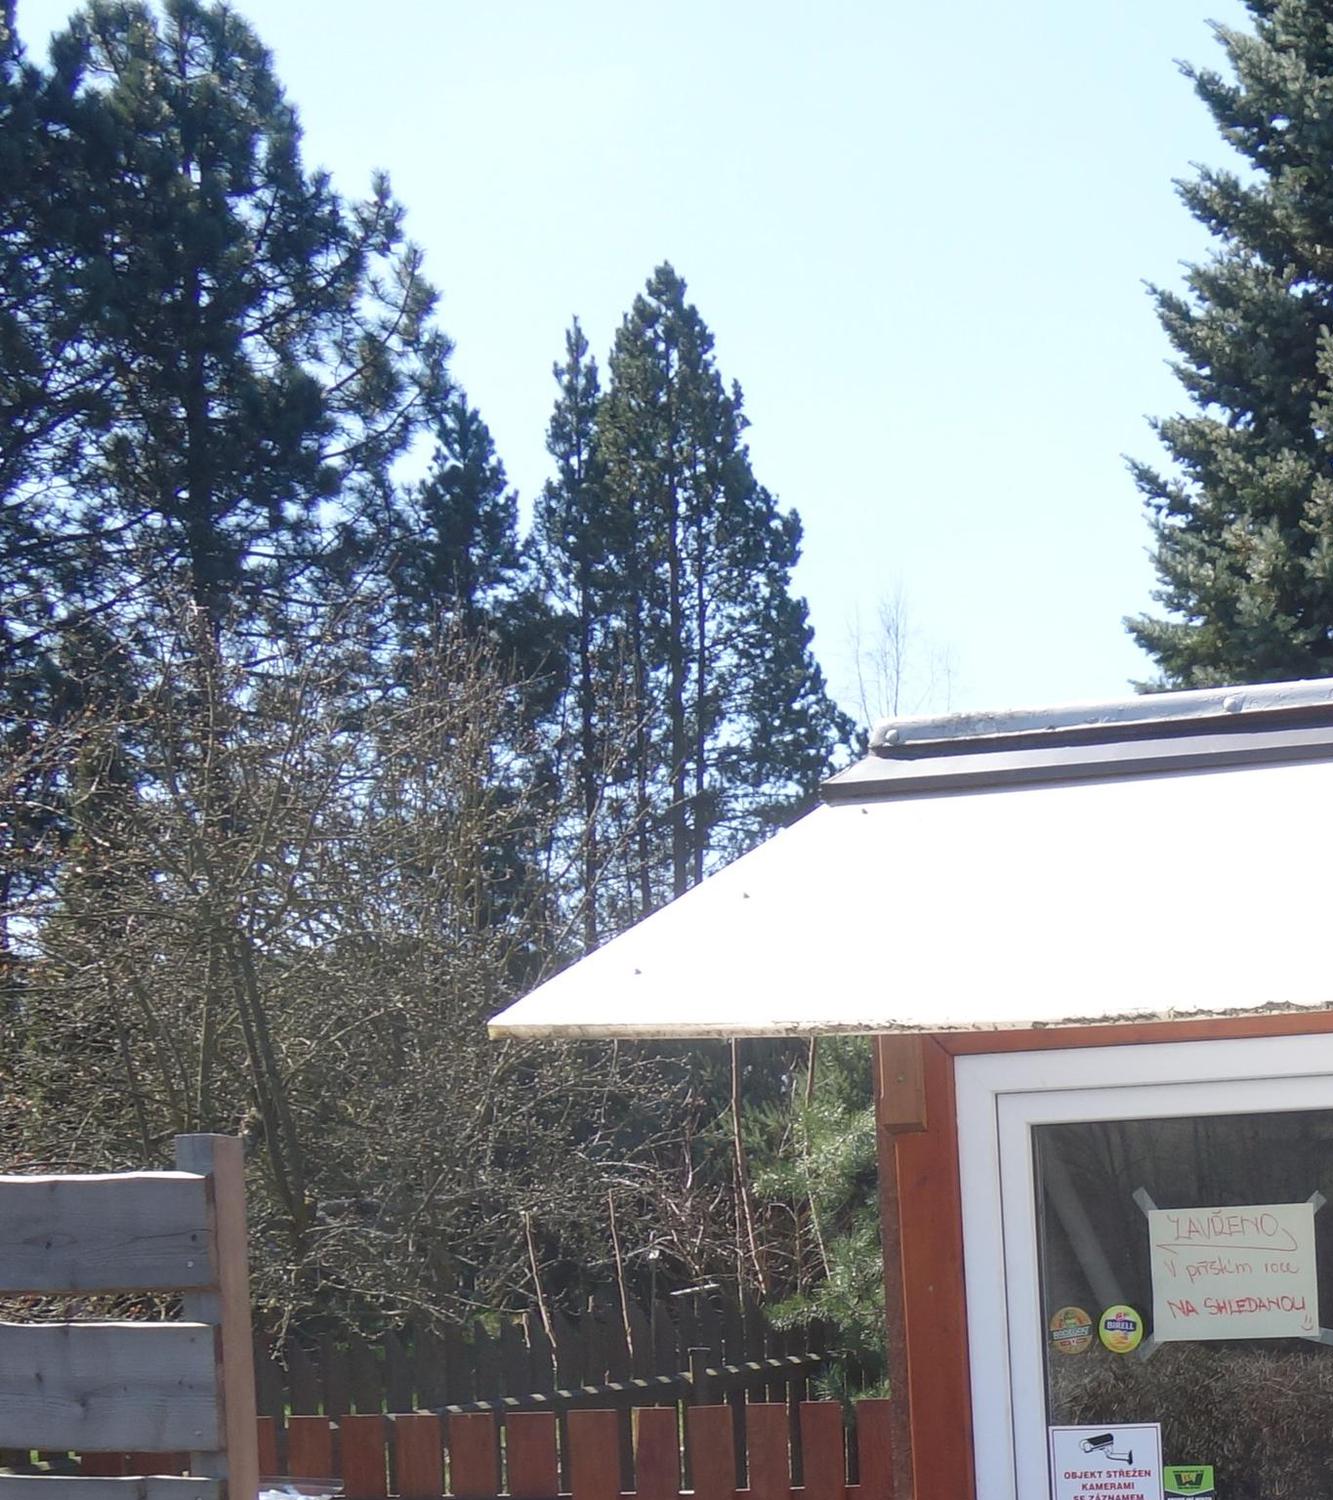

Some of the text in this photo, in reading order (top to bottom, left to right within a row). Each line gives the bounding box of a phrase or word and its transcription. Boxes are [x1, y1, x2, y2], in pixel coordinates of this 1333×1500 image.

[1167, 1210, 1279, 1240] ZAVŘENO
[1167, 1296, 1307, 1319] NA SHLEDANOU
[1063, 1468, 1152, 1480] OBJEKT STŘEŽEN
[1081, 1481, 1136, 1491] KAMERAMI
